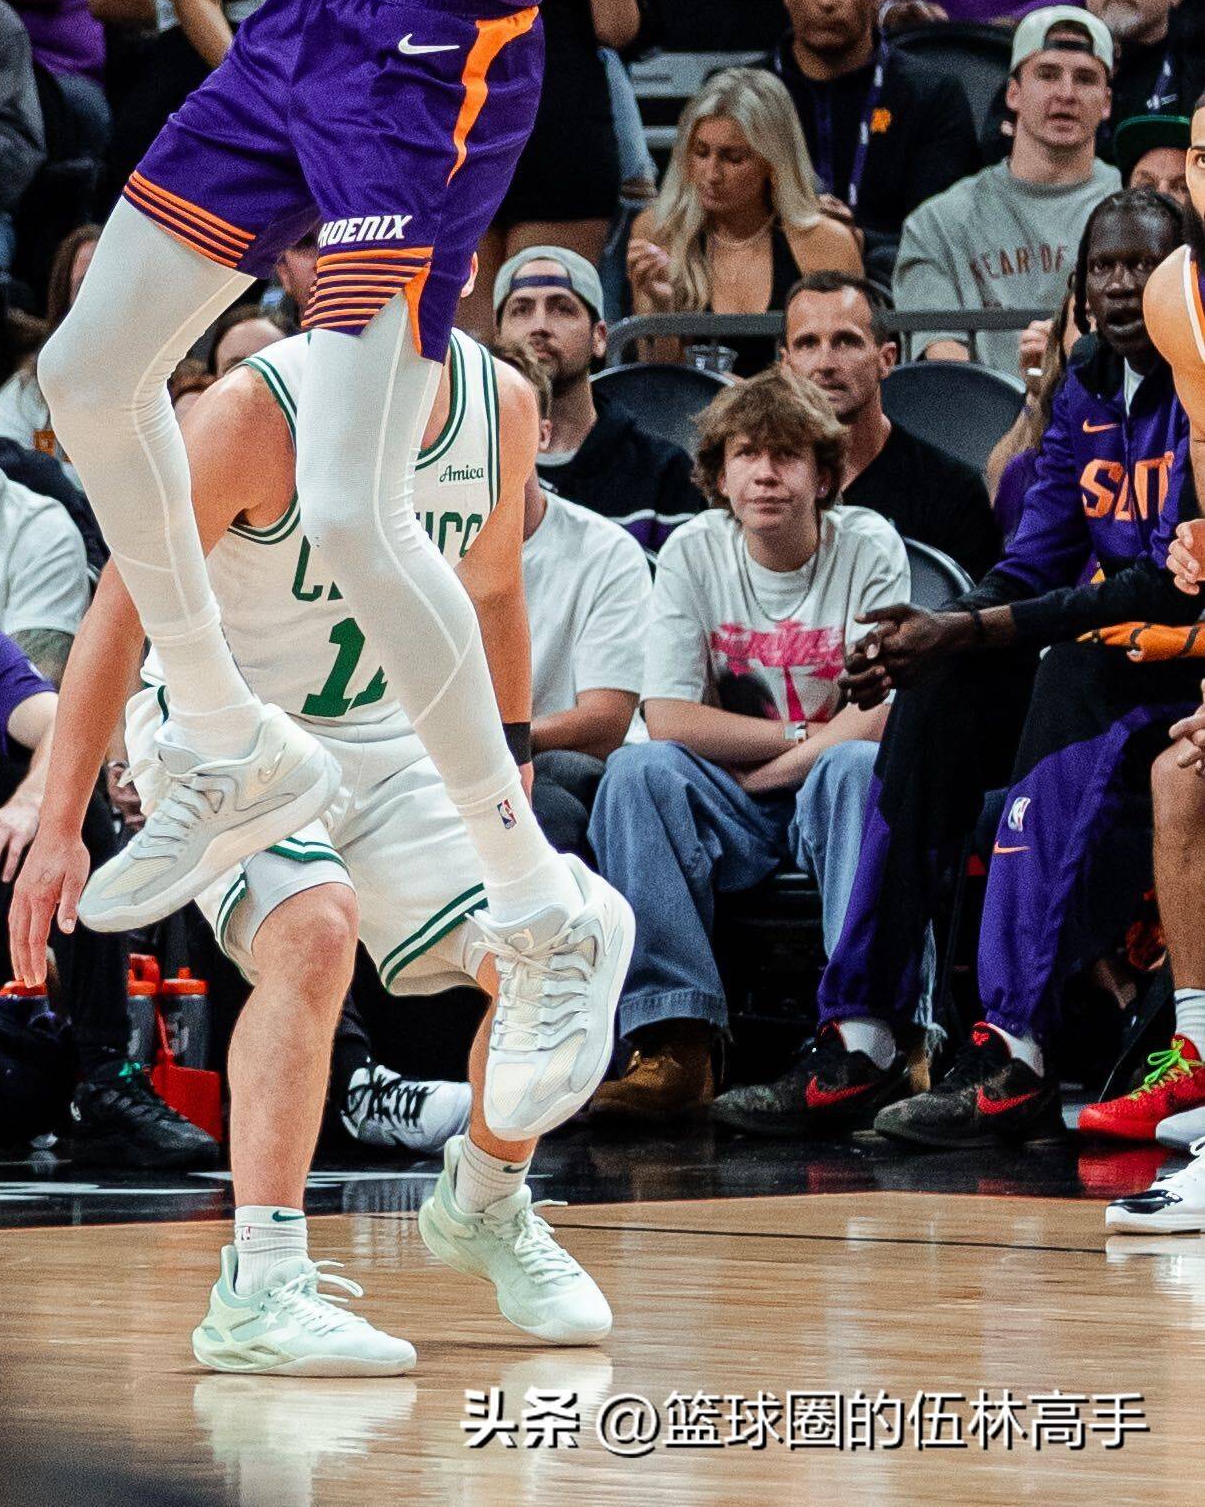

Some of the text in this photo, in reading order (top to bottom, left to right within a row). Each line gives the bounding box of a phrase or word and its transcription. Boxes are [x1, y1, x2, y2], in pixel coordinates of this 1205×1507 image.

[317, 215, 413, 248] HOENIX
[439, 464, 484, 483] Amica
[1079, 450, 1175, 522] SUN
[300, 617, 388, 717] 1
